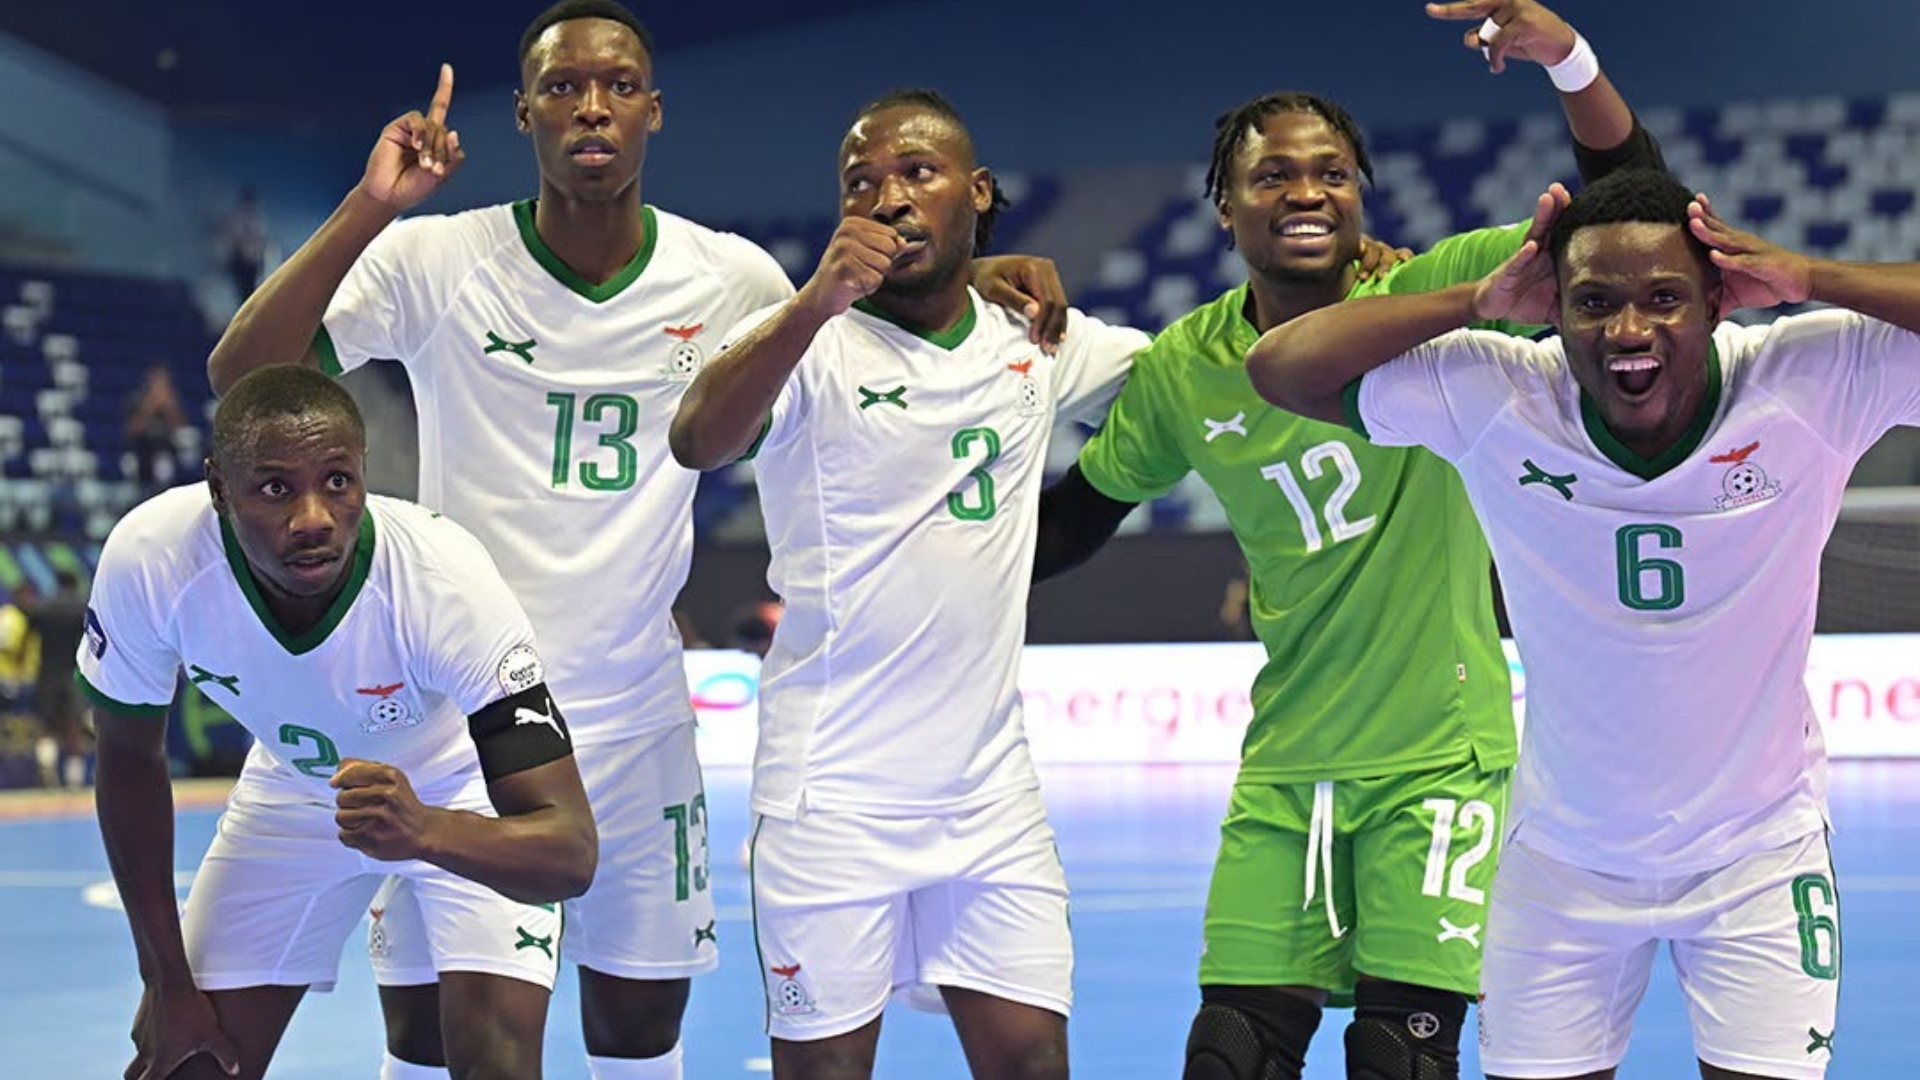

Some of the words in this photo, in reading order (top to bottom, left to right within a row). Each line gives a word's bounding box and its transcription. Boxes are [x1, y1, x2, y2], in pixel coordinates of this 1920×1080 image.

[546, 392, 638, 491] 13
[946, 427, 1000, 522] 3
[1260, 440, 1377, 554] 12
[1615, 523, 1685, 610] 6
[278, 723, 340, 780] 2
[1422, 798, 1495, 906] 12
[1791, 873, 1837, 980] 6
